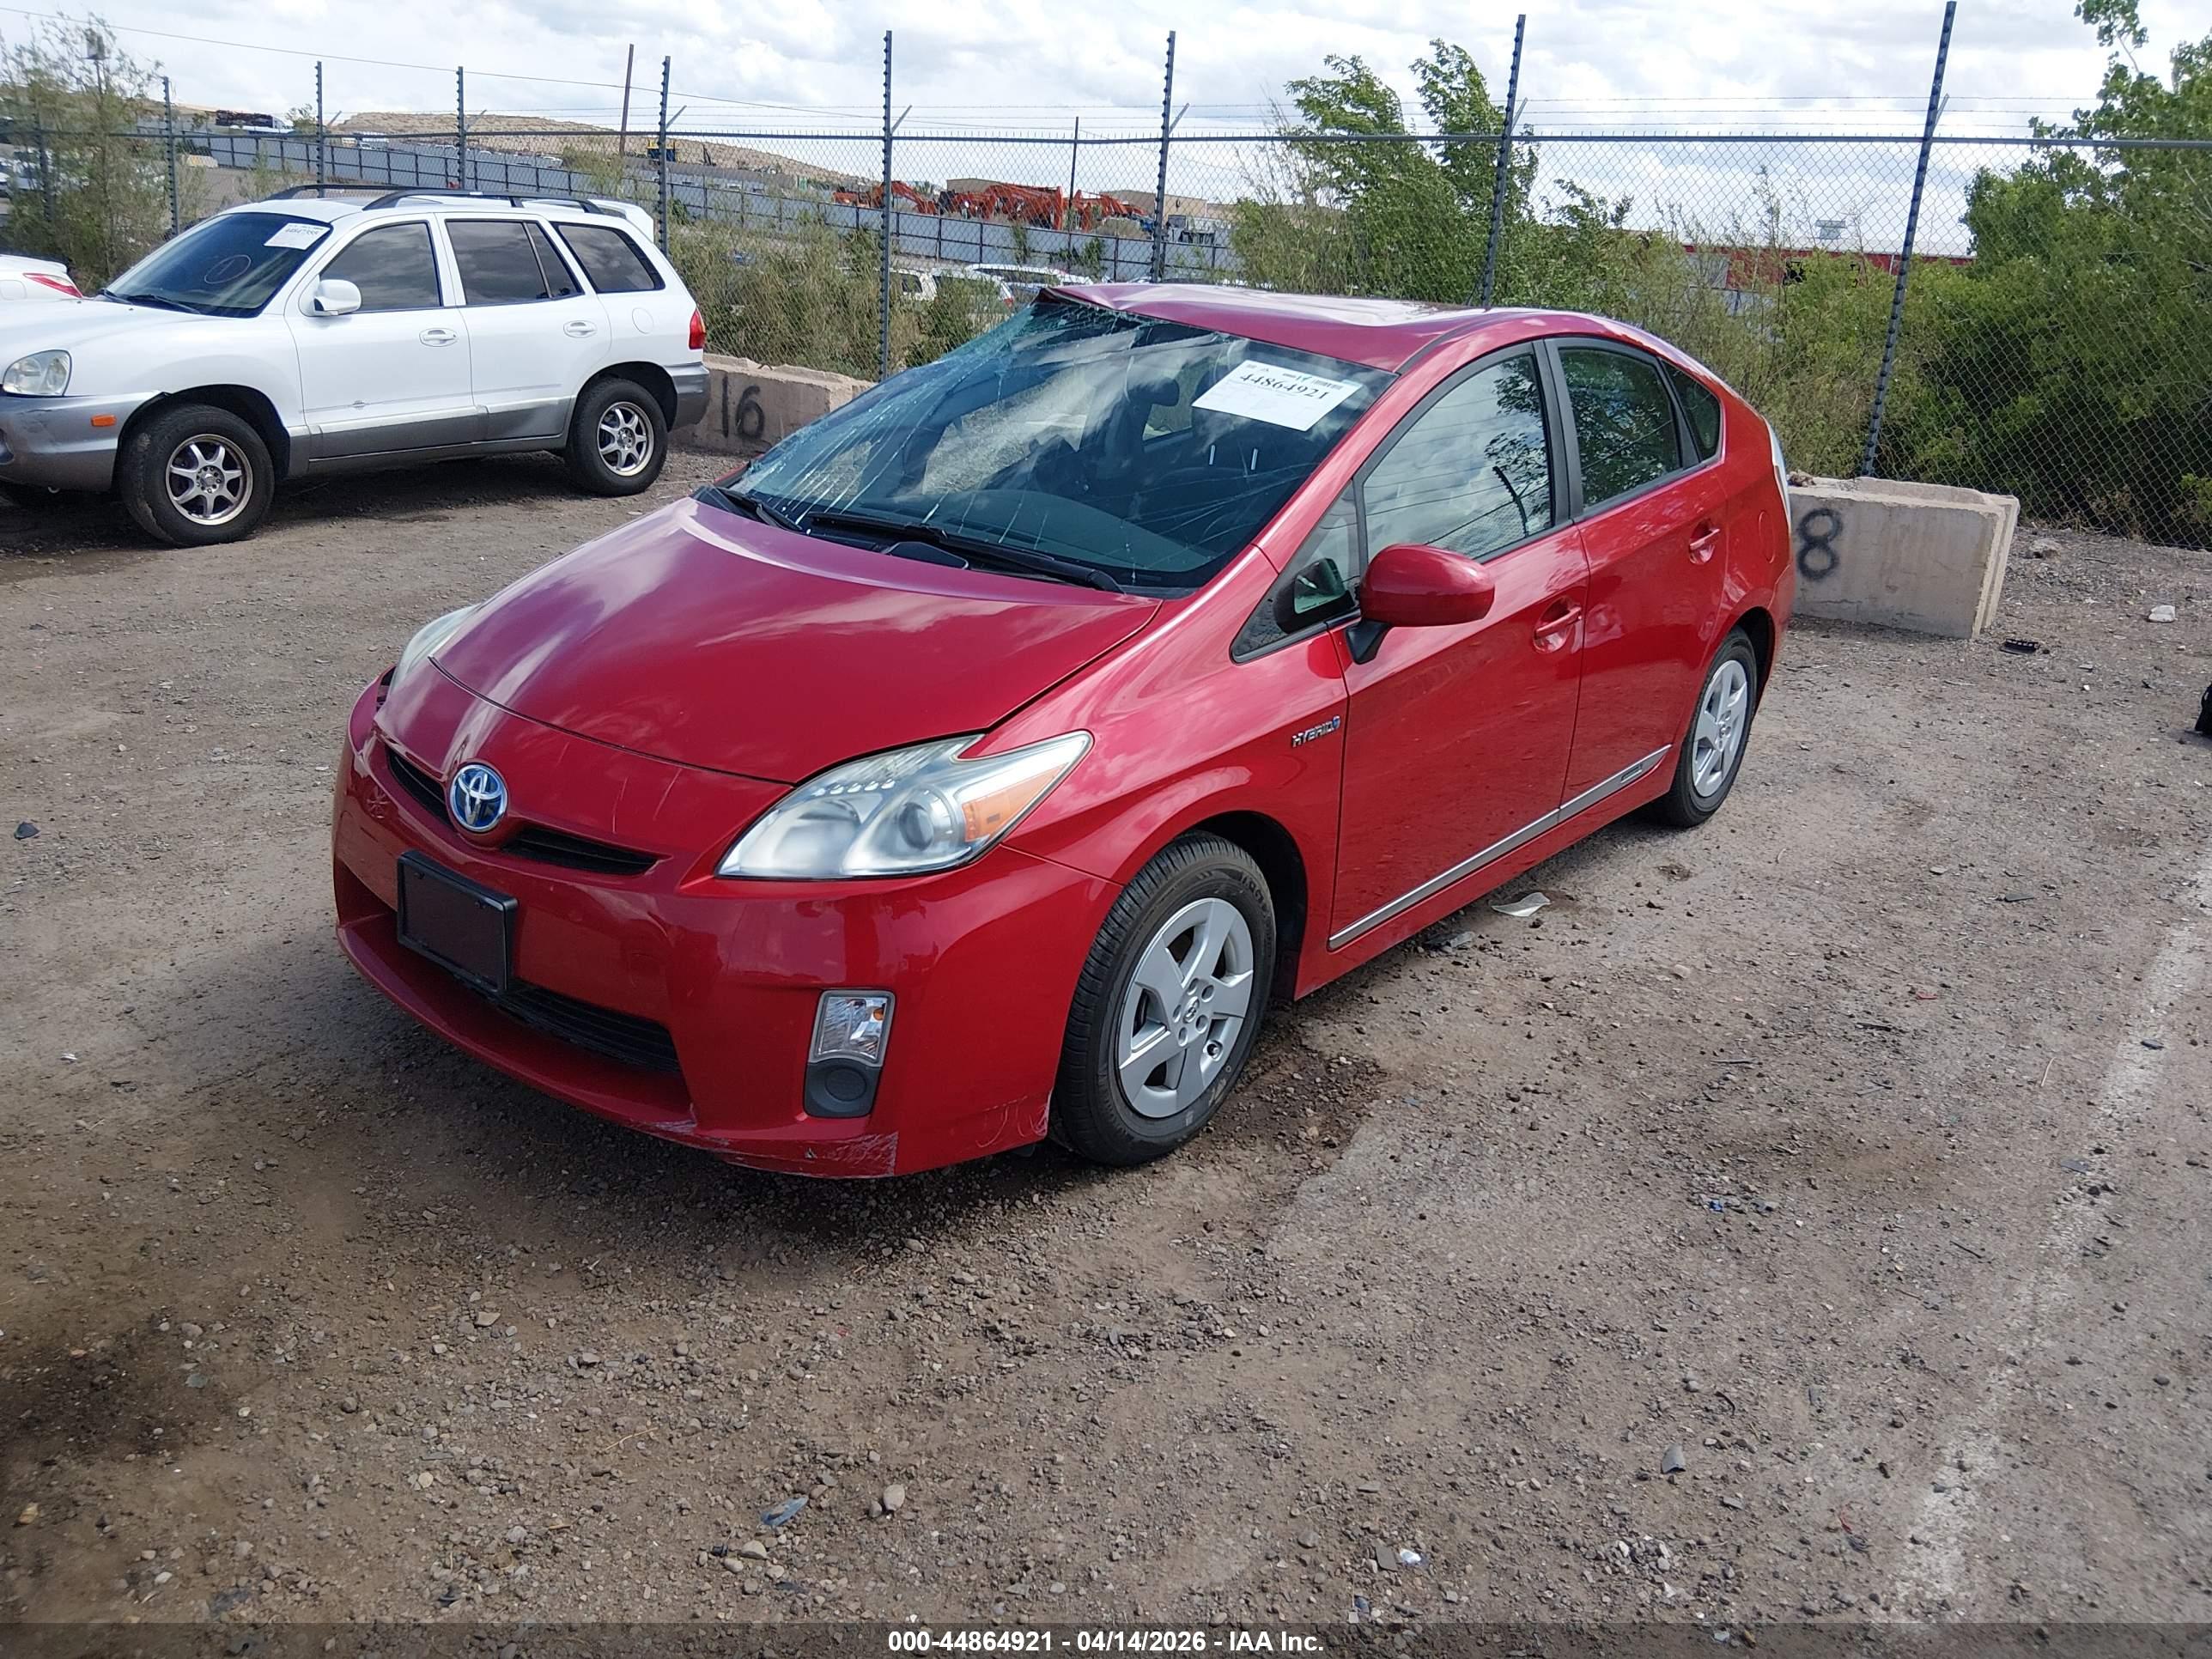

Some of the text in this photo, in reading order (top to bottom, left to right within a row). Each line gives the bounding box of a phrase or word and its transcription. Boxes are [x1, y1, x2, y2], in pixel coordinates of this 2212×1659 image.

[722, 376, 764, 439] 16
[1240, 374, 1329, 399] 44864921
[1798, 508, 1841, 580] 8
[1291, 720, 1336, 748] HYBRID
